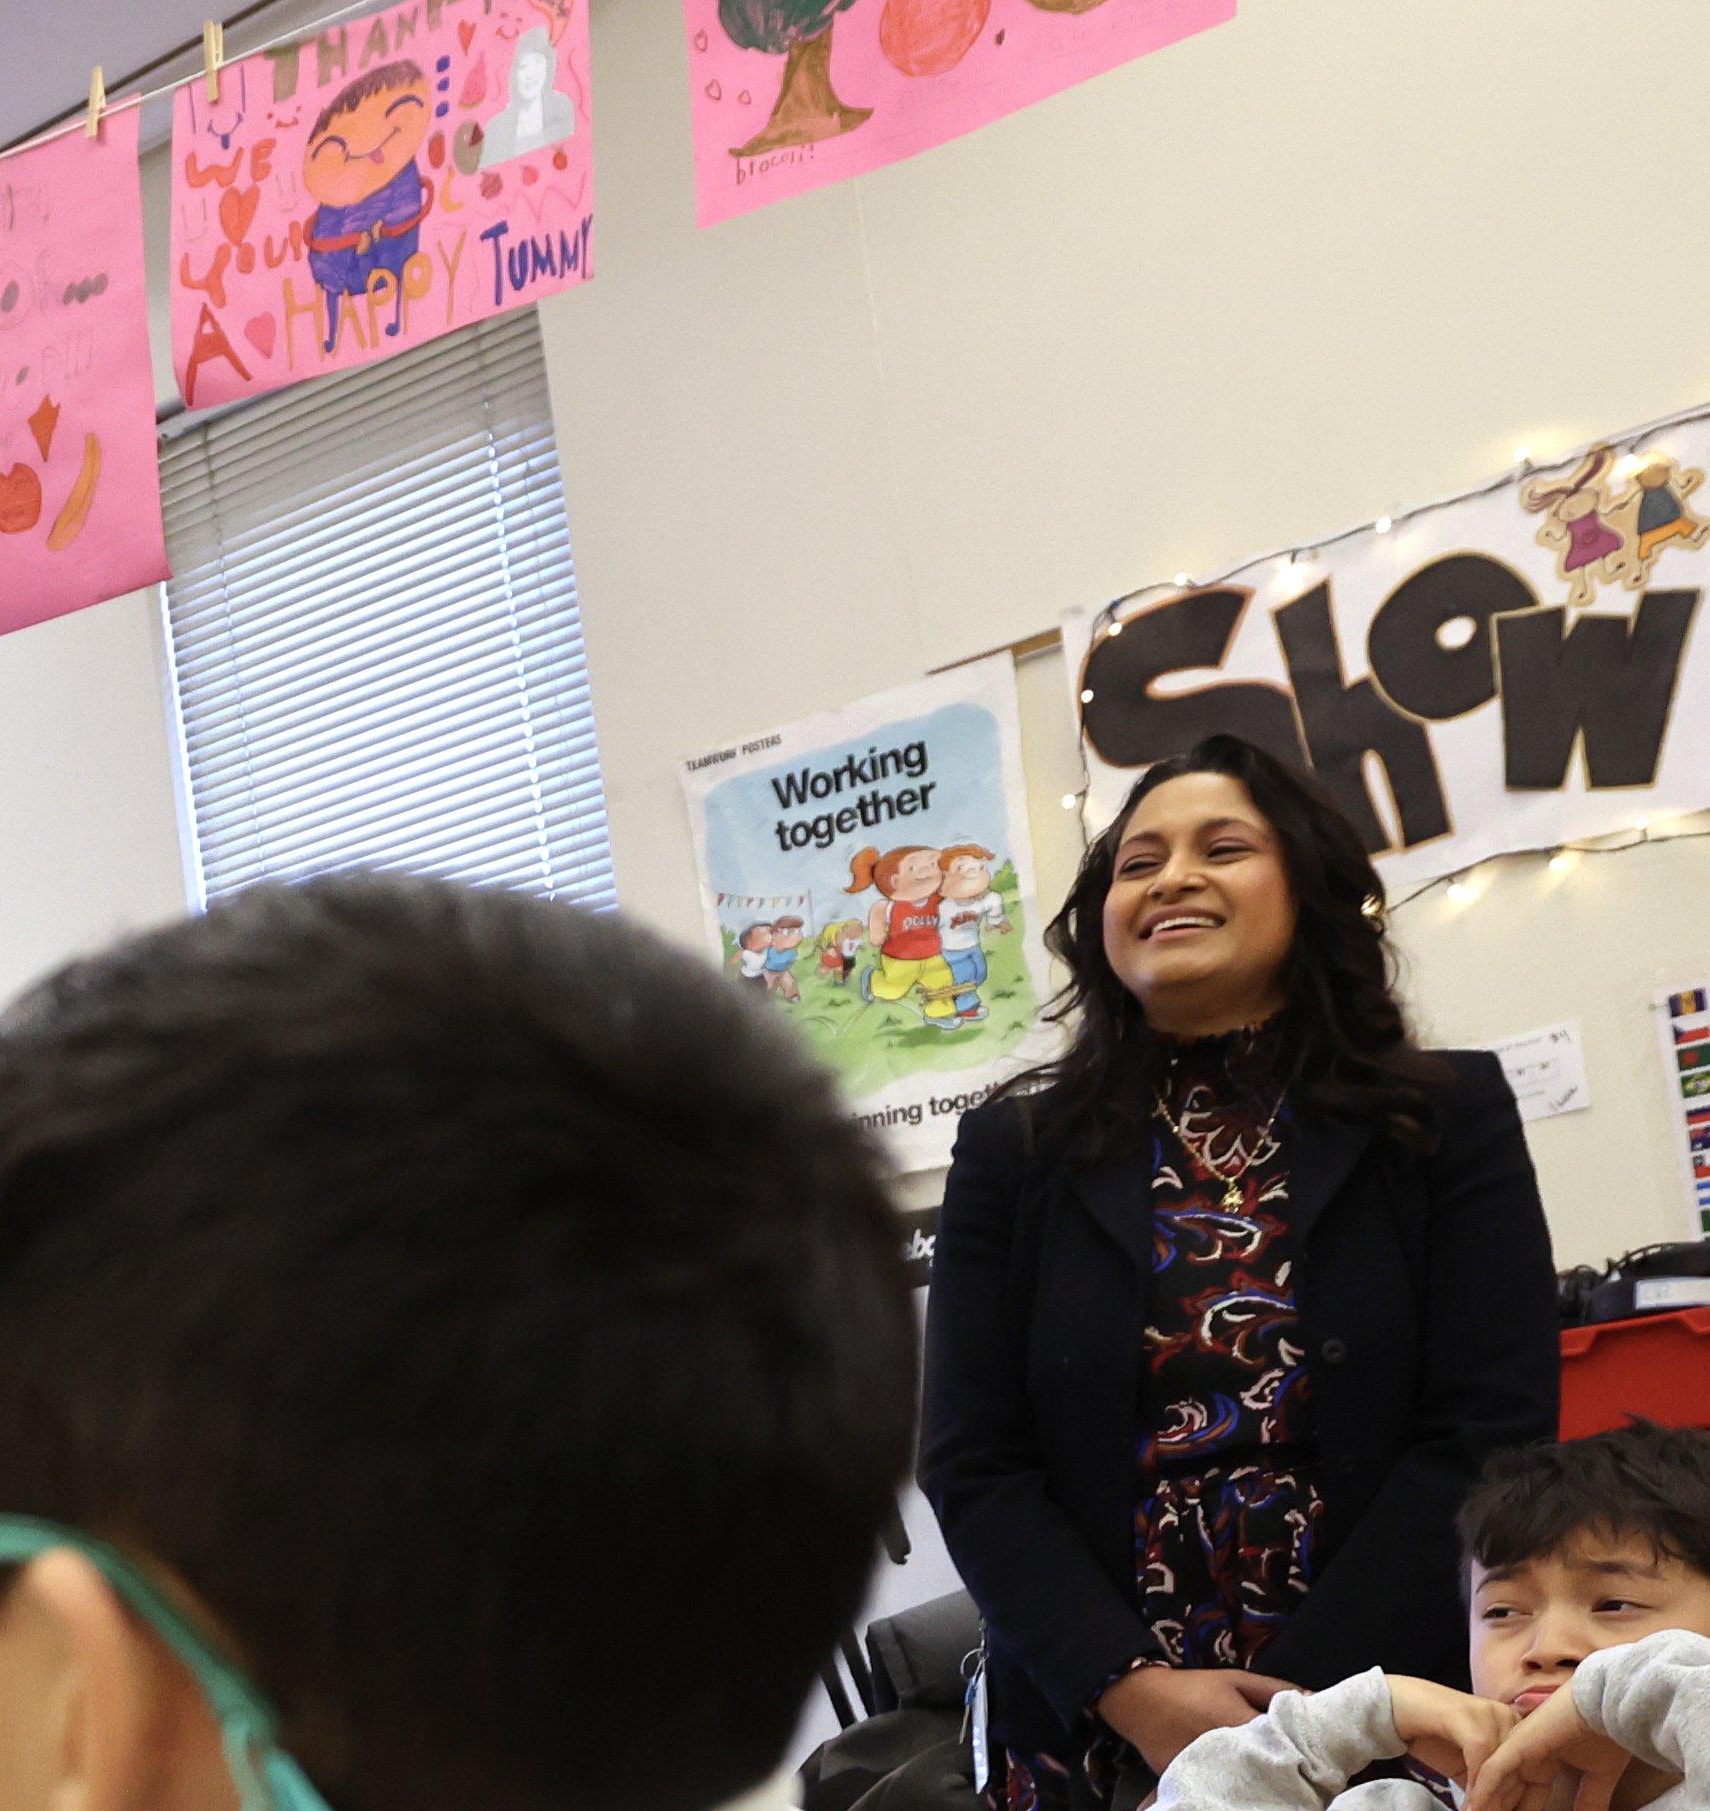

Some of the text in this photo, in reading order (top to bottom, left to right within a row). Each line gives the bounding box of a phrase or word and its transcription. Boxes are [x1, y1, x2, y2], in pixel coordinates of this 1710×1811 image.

[186, 302, 253, 407] A
[480, 213, 594, 307] TUMMY
[741, 734, 782, 756] POSTERS
[771, 739, 929, 809] Working
[775, 781, 937, 852] together
